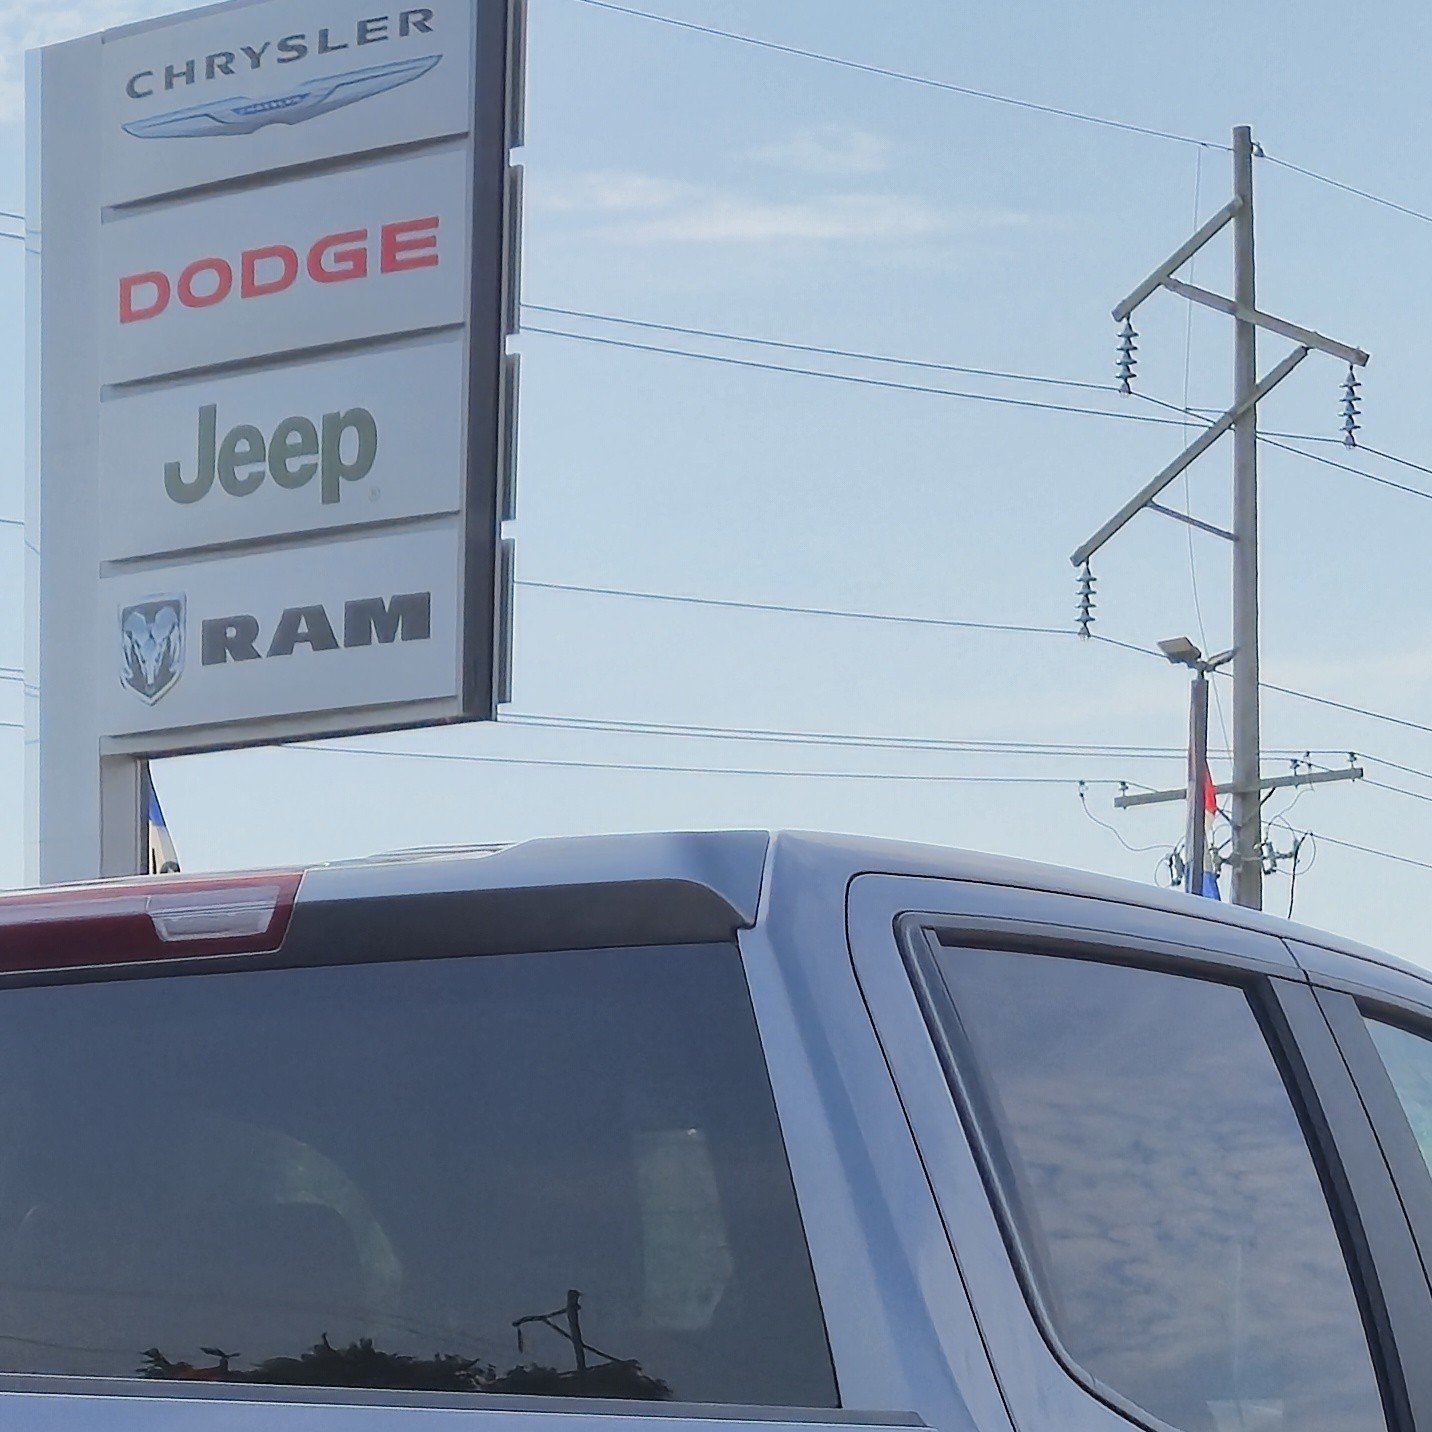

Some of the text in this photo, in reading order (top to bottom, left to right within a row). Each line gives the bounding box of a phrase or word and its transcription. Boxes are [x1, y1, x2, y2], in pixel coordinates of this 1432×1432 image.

[124, 8, 436, 101] CHRYSLER
[119, 216, 440, 325] DODGE
[163, 403, 379, 505] Jeep
[200, 591, 432, 668] RAM
